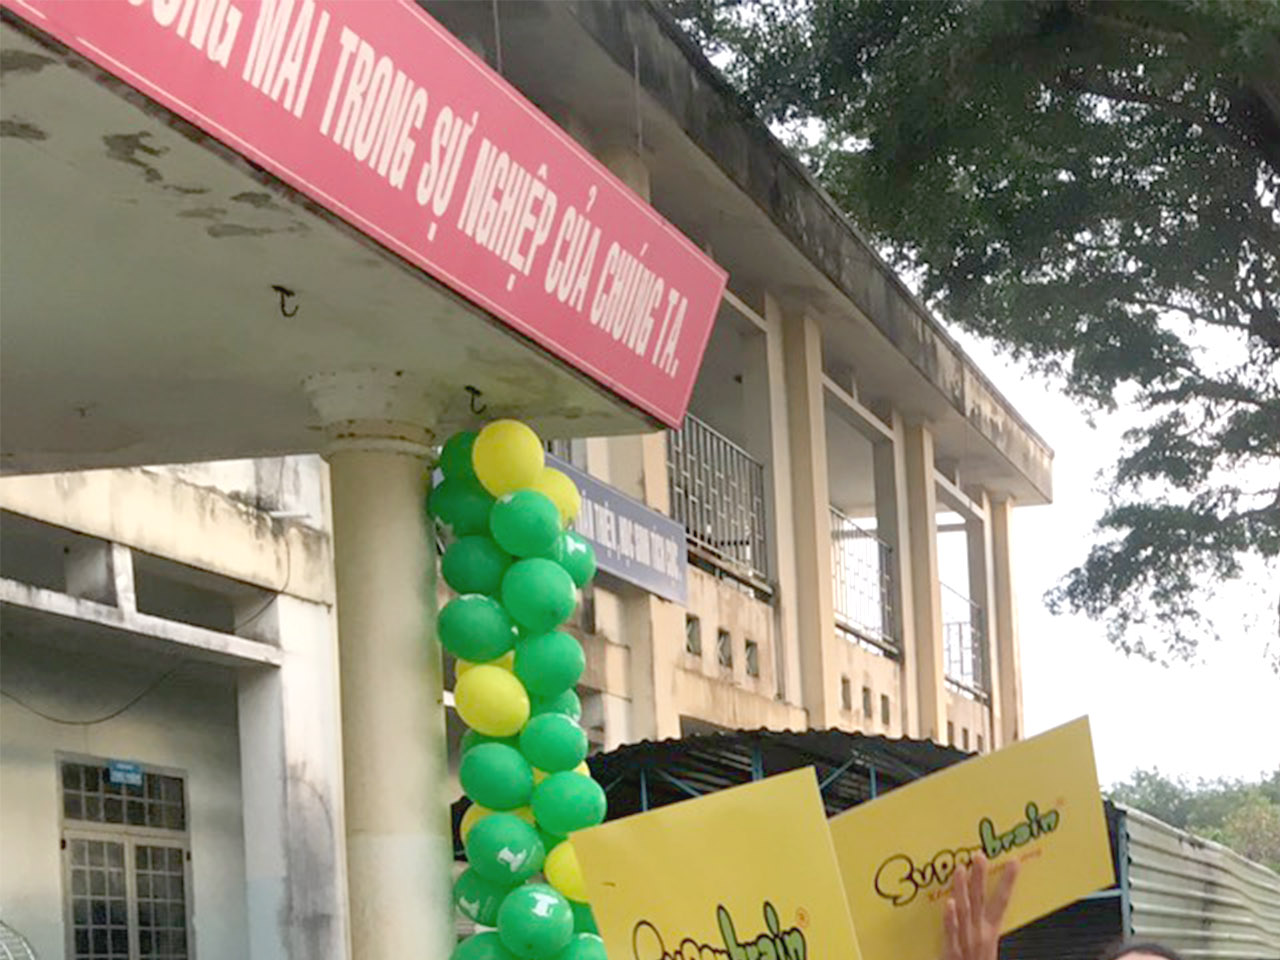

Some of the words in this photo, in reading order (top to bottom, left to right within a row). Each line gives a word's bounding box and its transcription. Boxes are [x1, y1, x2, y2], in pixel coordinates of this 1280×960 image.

[319, 25, 428, 190] TRONG
[416, 106, 479, 242] SỰ
[457, 137, 558, 292] NGHIỆP
[544, 184, 601, 312] CỦA
[590, 241, 664, 357] CHÚNG
[652, 288, 688, 378] TA.
[874, 801, 1060, 907] Supebrain
